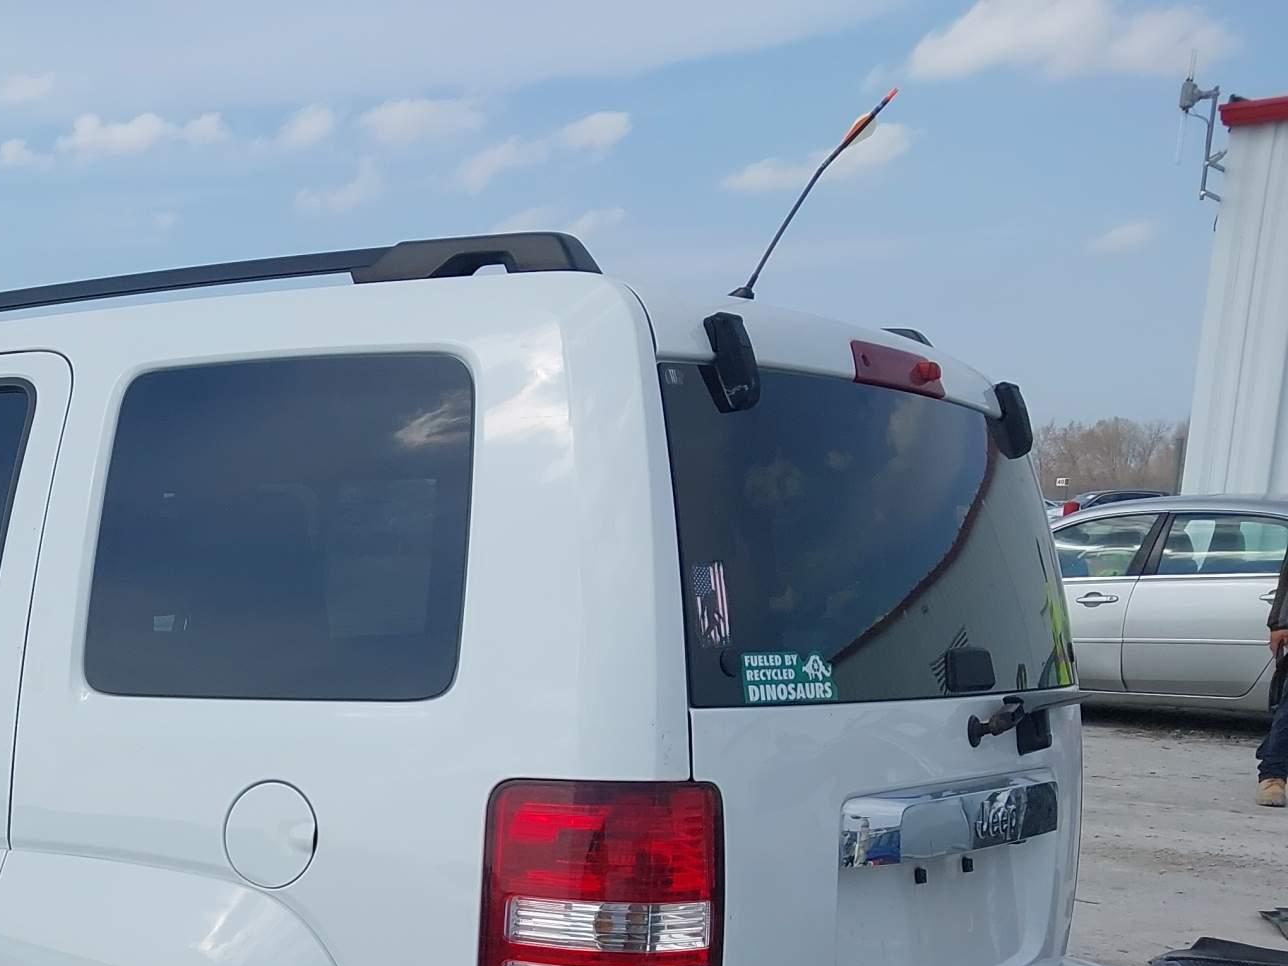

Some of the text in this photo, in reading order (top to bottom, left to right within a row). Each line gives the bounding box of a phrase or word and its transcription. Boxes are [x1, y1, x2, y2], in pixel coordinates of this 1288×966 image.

[744, 653, 798, 667] FUELED BY
[746, 667, 795, 681] RECYCLED
[748, 682, 832, 701] DINOSAURS
[975, 800, 1017, 841] Jeep
